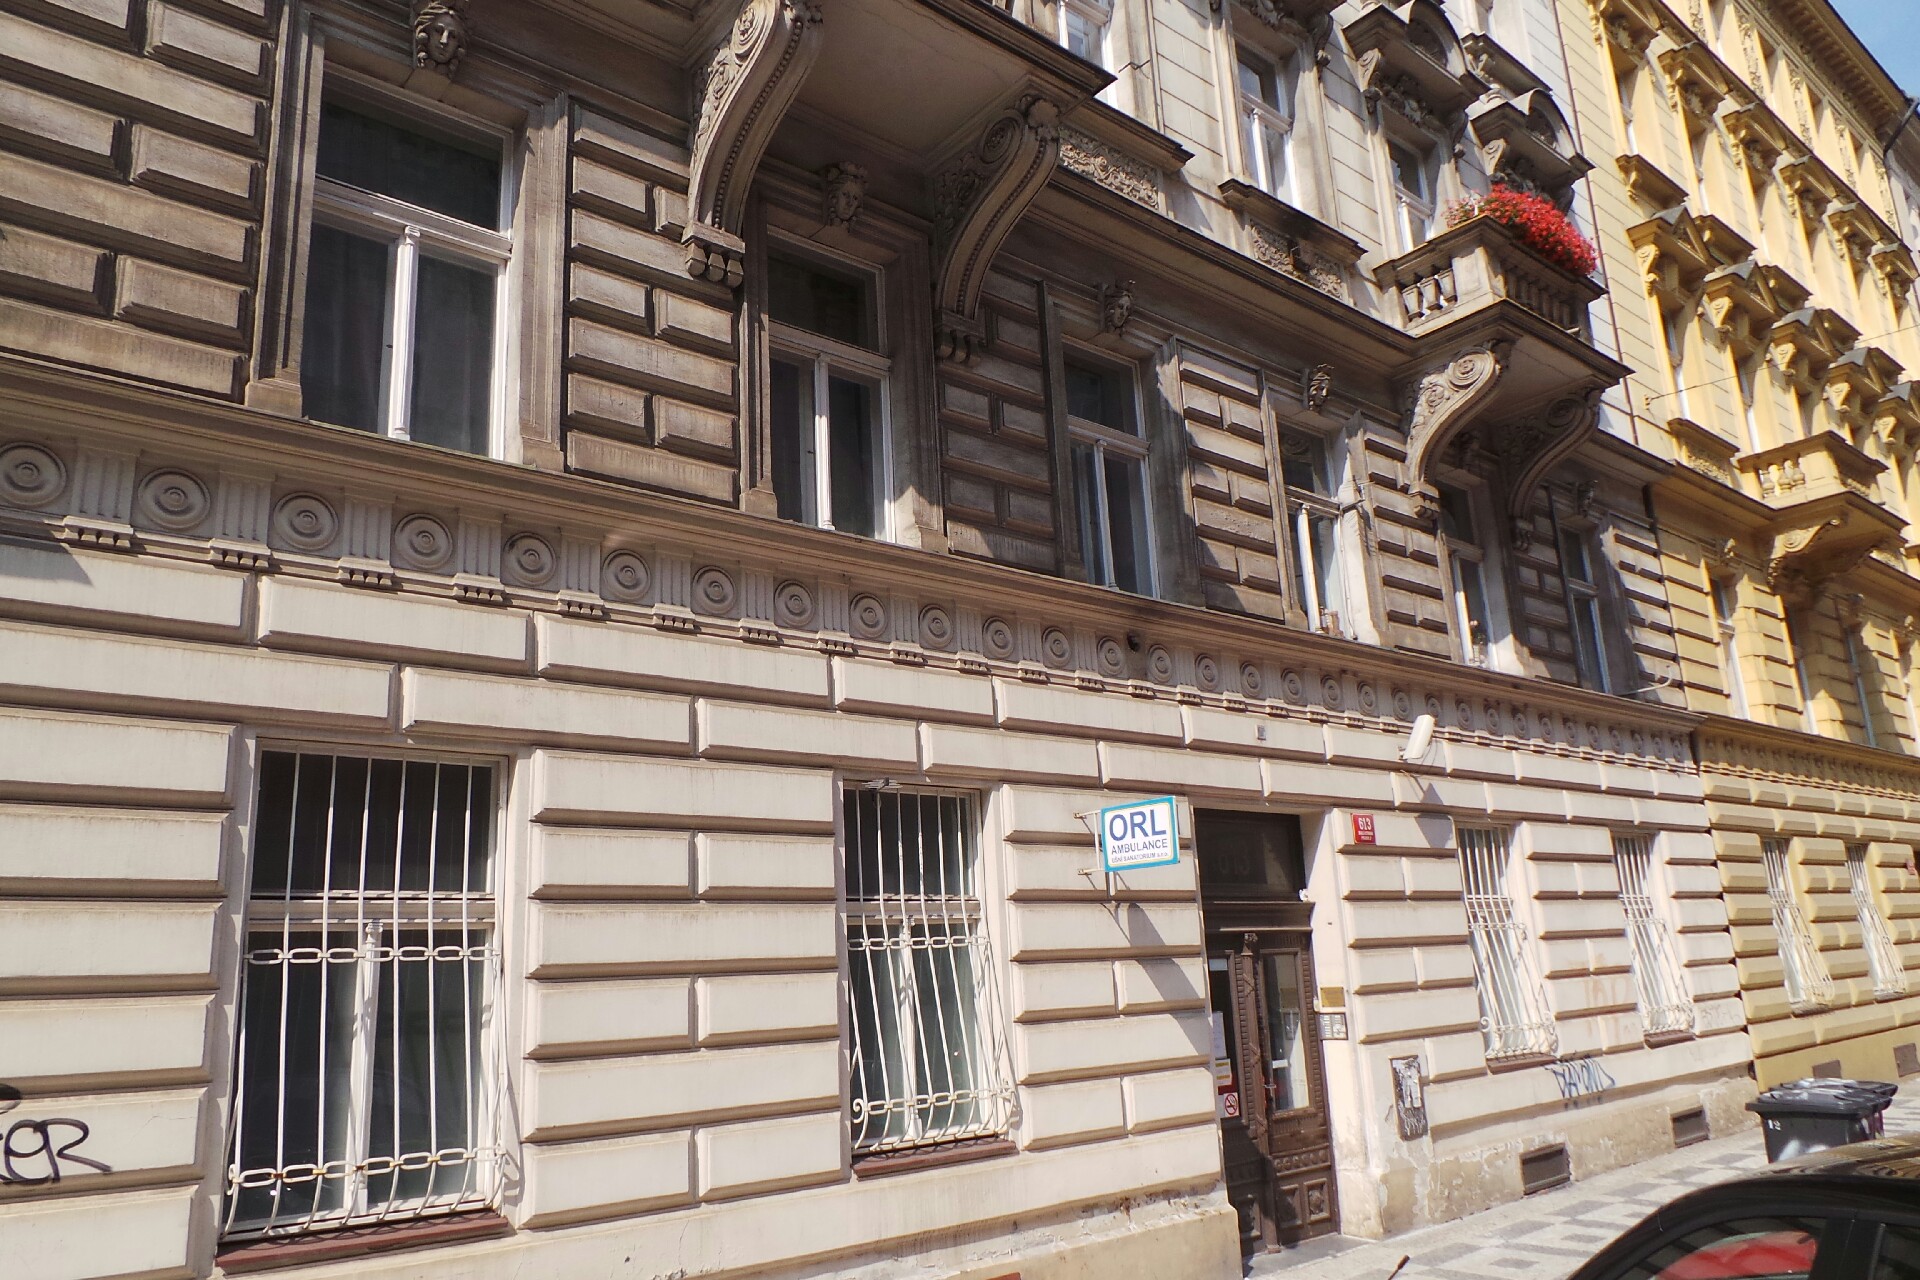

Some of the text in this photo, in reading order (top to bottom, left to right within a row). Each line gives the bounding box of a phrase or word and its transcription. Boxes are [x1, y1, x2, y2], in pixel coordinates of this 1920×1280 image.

[1109, 809, 1167, 842] ORL
[1358, 817, 1371, 830] 613
[1111, 838, 1168, 855] AMBULANCE
[1123, 852, 1156, 862] SANATORIUM
